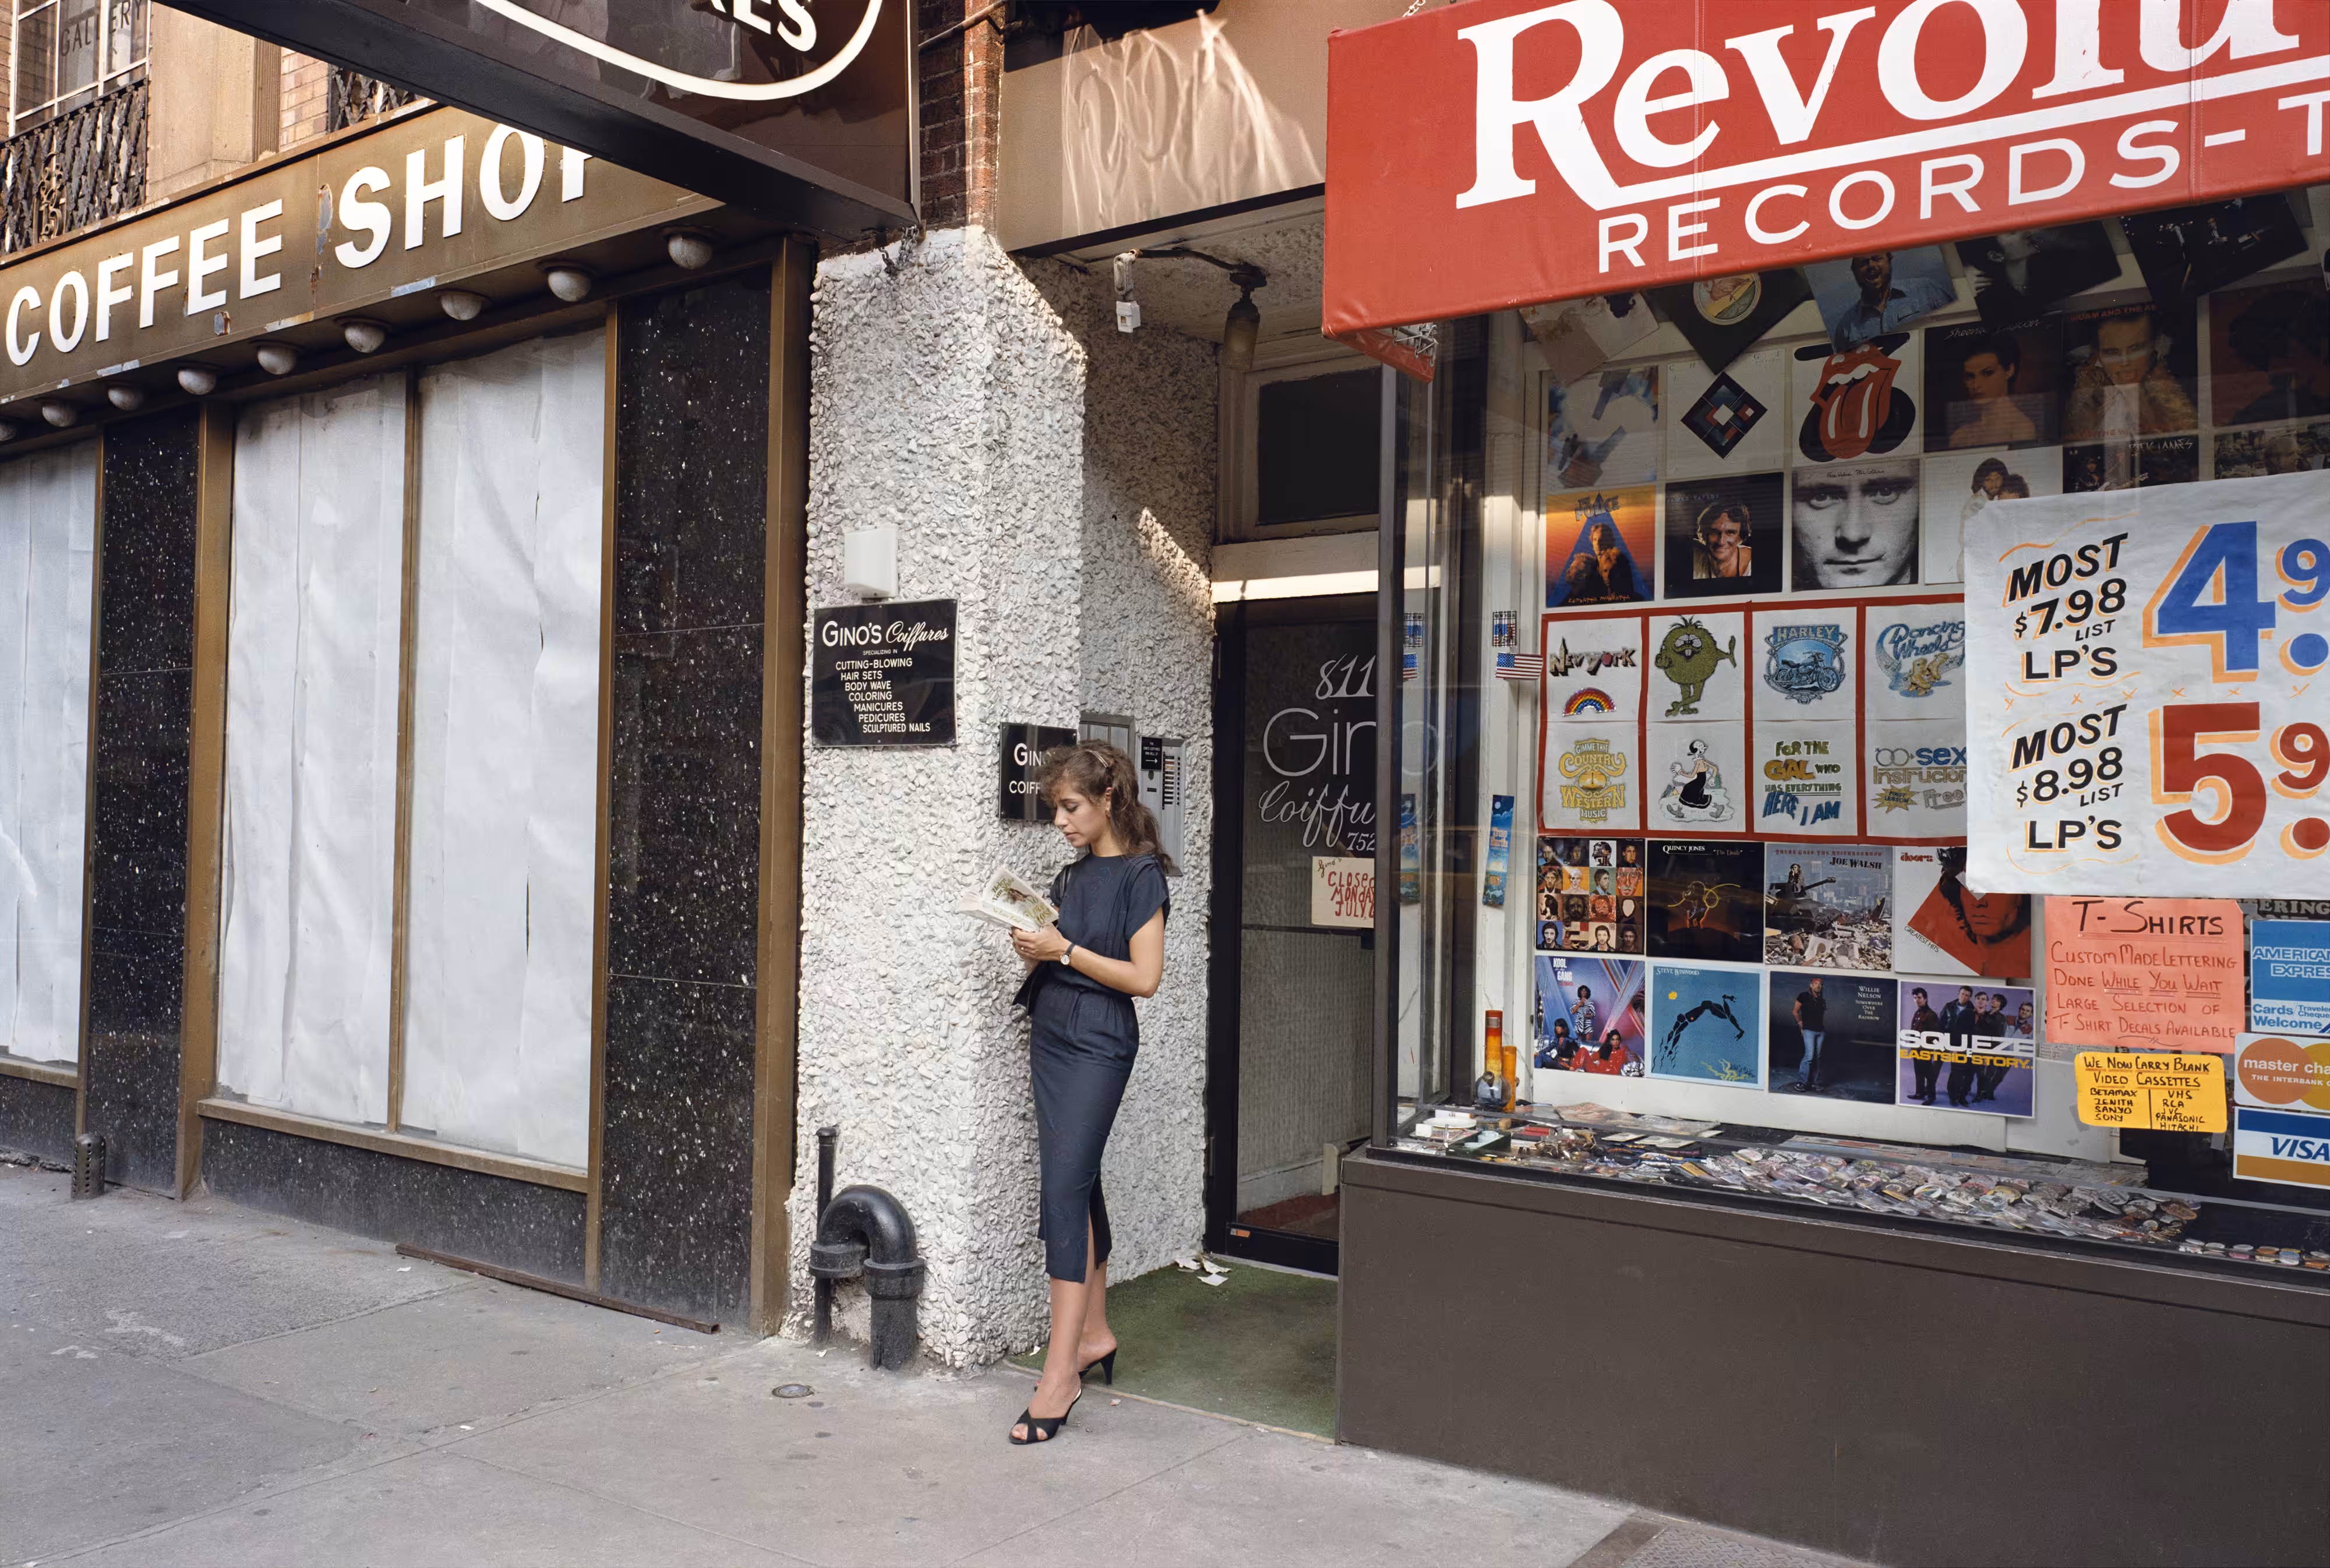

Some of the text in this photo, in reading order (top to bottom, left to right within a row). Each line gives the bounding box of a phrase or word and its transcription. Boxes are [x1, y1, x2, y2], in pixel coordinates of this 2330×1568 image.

[712, 0, 817, 52] ES
[6, 199, 283, 366] COFFEE
[2004, 532, 2128, 606] MOST
[2014, 577, 2127, 639] $7.98
[822, 621, 948, 652] GINO'S Coiffures
[1777, 626, 1837, 645] HARLEY
[2075, 620, 2116, 641] LIST
[835, 658, 913, 670] CUTTING-BLOWING
[2022, 644, 2118, 682] LP'S
[841, 670, 882, 681] HAIR SETS
[1315, 653, 1376, 700] 811
[845, 680, 891, 691] BODY WAVE
[848, 691, 892, 701] COLORING
[854, 701, 903, 712] MANICURES
[859, 713, 905, 723] PEDICURES
[863, 722, 931, 733] SCULPTURED NAILS
[2008, 704, 2127, 772] MOST
[1915, 747, 1967, 765] sex
[1559, 753, 1626, 778] COUNTRY
[1764, 759, 1841, 781] GAL WHO
[2017, 747, 2123, 808] $8.98
[1764, 783, 1841, 792] HAS EVERYTHING
[2080, 783, 2124, 807] LIST
[1561, 785, 1625, 808] WESTERN
[1580, 808, 1607, 818] MUSIC
[1762, 791, 1841, 826] HERE I AM
[2025, 815, 2123, 852] LP'S
[1662, 845, 1687, 854] QUINCY
[1830, 857, 1882, 870] JOE WALSH
[2237, 898, 2330, 914] ERING
[1927, 942, 1939, 953] HITS
[2051, 941, 2237, 968] CUSTOM MADE LETTERING
[1553, 958, 1567, 968] KOOL
[1557, 971, 1572, 981] GANG
[2054, 968, 2223, 991] DONE WHILE YOU WAIT
[2057, 993, 2220, 1015] LARGE SELECTION OF
[2253, 1004, 2293, 1015] Cards
[2119, 1016, 2160, 1035] DECALS
[2167, 1021, 2236, 1037] AVAILABLE
[2253, 1015, 2322, 1029] Welcome
[2084, 1055, 2211, 1072] WE NOW CARRY BLANK
[2244, 1059, 2299, 1072] master
[2094, 1071, 2201, 1087] VIDEO CASSETTES
[2273, 1076, 2323, 1086] INTERBANK
[2090, 1087, 2138, 1097] BETAMAX
[2167, 1090, 2193, 1099] VHS
[2094, 1099, 2133, 1107] ZENITH
[2095, 1106, 2132, 1114] SANYO
[2162, 1099, 2184, 1108] RCA
[2094, 1114, 2123, 1122] SONY
[2155, 1113, 2205, 1123] PANASONIC
[2160, 1122, 2199, 1132] HITACHI
[2270, 1136, 2330, 1161] VISA
